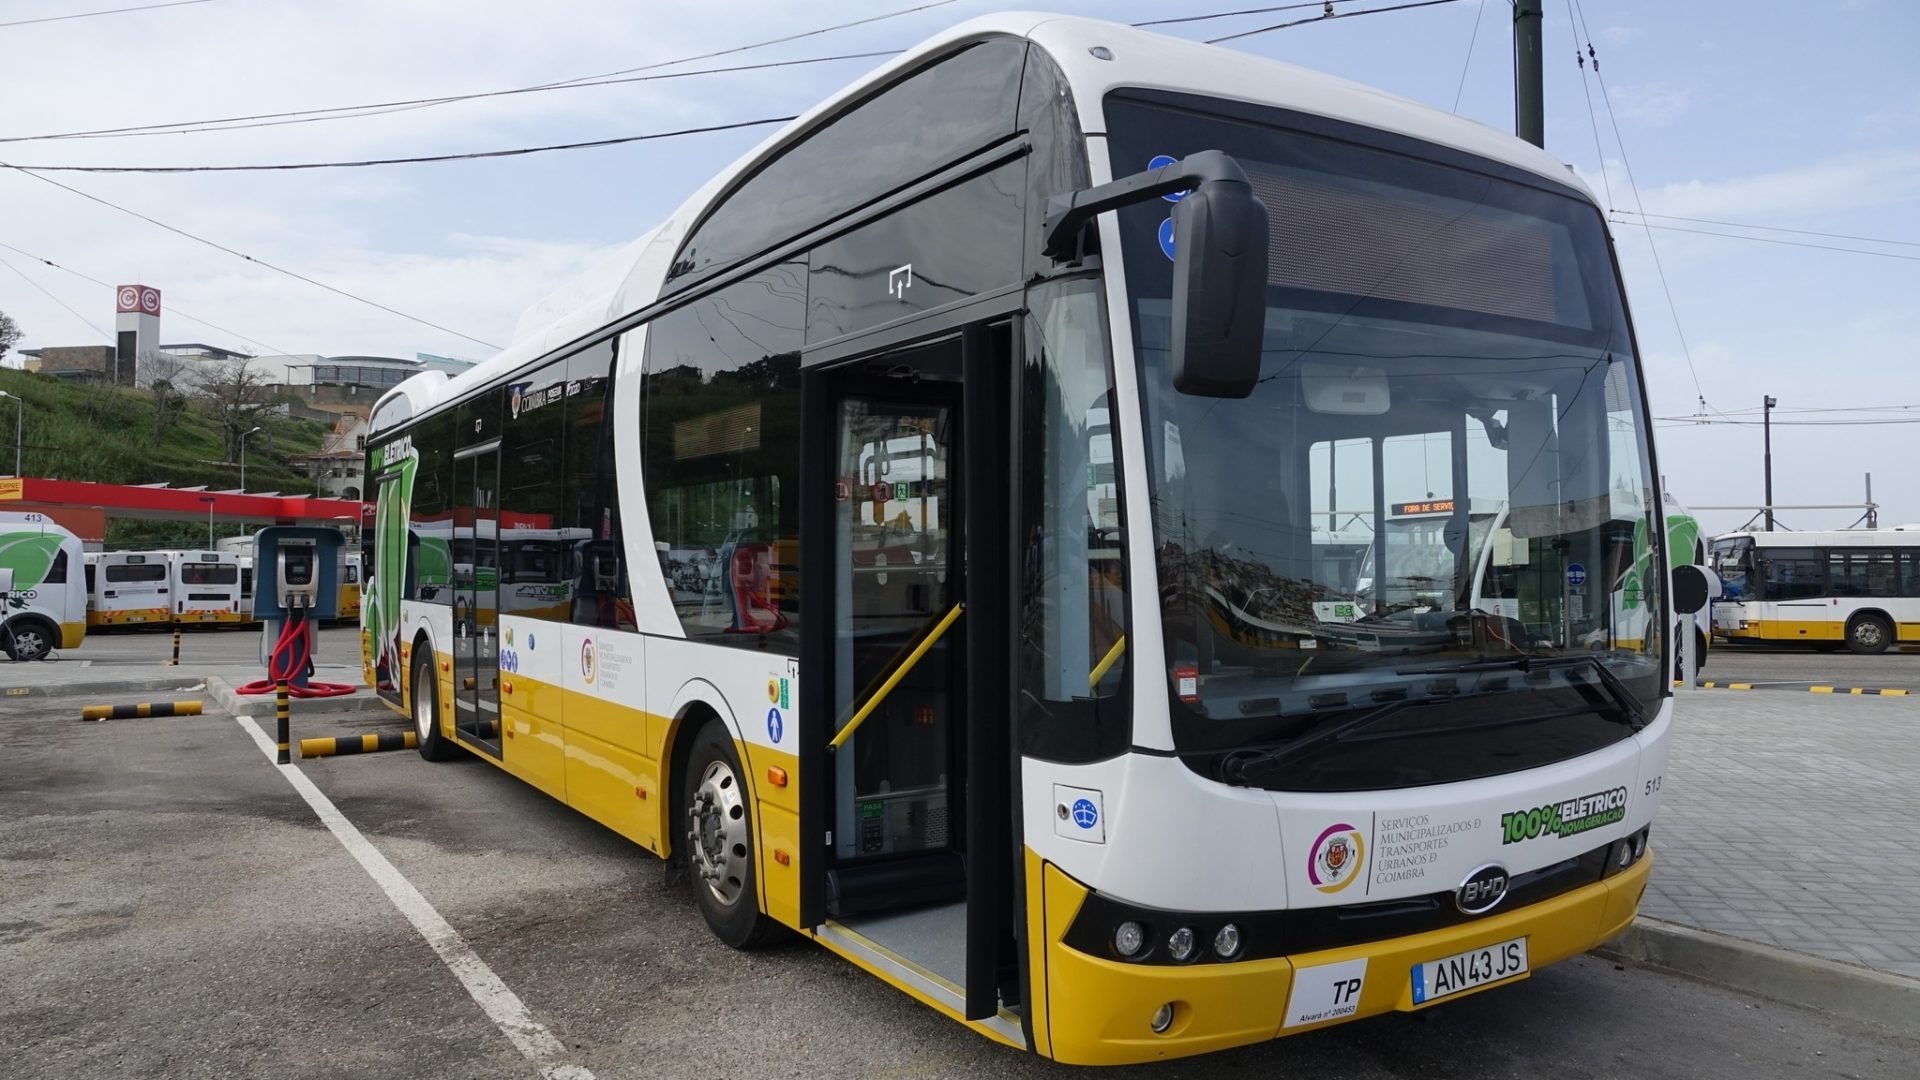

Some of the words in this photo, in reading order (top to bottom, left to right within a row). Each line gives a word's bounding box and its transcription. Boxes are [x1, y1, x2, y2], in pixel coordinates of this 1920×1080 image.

[24, 513, 42, 523] 413
[1404, 504, 1420, 513] FORA
[1422, 503, 1431, 512] DE
[7, 590, 37, 600] RICO
[1644, 776, 1662, 796] 513
[1381, 814, 1430, 832] SERVIÇOS
[1502, 804, 1562, 844] 100%
[1380, 822, 1472, 845] MUNICIPALIZADOS
[1379, 838, 1449, 858] TRANSPORTES
[1378, 855, 1427, 872] URBANOS
[1376, 869, 1426, 885] COIMBRA
[1463, 877, 1505, 902] BYD
[1434, 957, 1465, 994] AN
[1469, 951, 1492, 982] 43
[1496, 943, 1521, 975] JS
[1333, 978, 1362, 1005] TP
